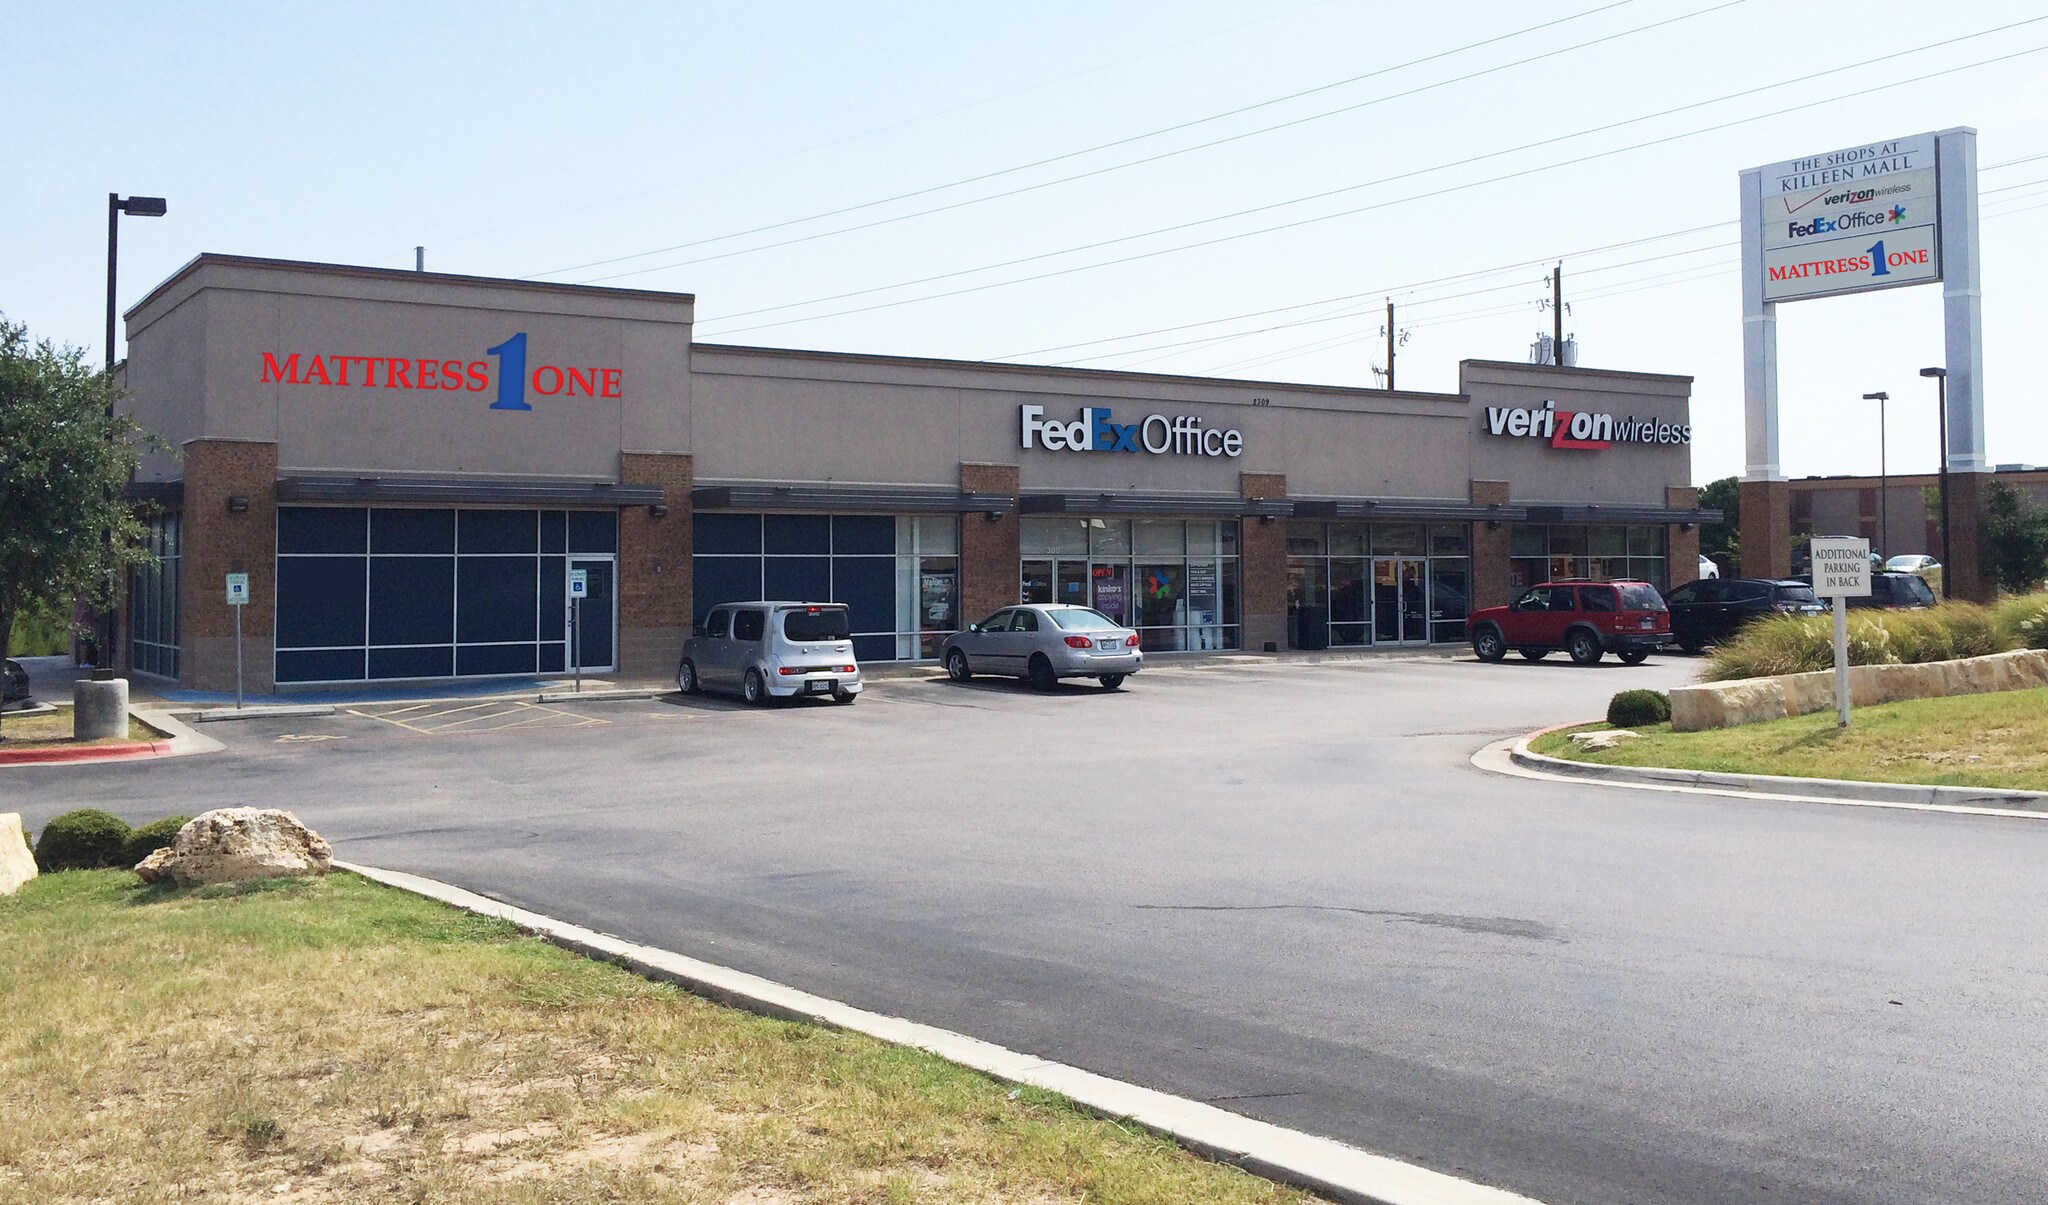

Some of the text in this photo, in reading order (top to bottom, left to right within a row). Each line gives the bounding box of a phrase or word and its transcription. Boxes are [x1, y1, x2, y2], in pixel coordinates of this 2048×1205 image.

[1792, 141, 1900, 172] THE SHOPS AT
[1782, 156, 1912, 192] KILLEEN MALL
[1824, 183, 1911, 206] verizon wireless
[1788, 210, 1884, 239] FedEx Office
[1768, 240, 1929, 282] MATTRESS 1 ONE
[260, 332, 622, 412] MATTRESS 1 ONE
[1019, 404, 1243, 458] FedEx Office
[1488, 400, 1692, 450] verizon wireless
[1815, 549, 1867, 560] ADDITIONAL
[1824, 562, 1860, 573] PARKING
[1092, 568, 1112, 577] OPEN
[1826, 577, 1860, 587] IN BACK
